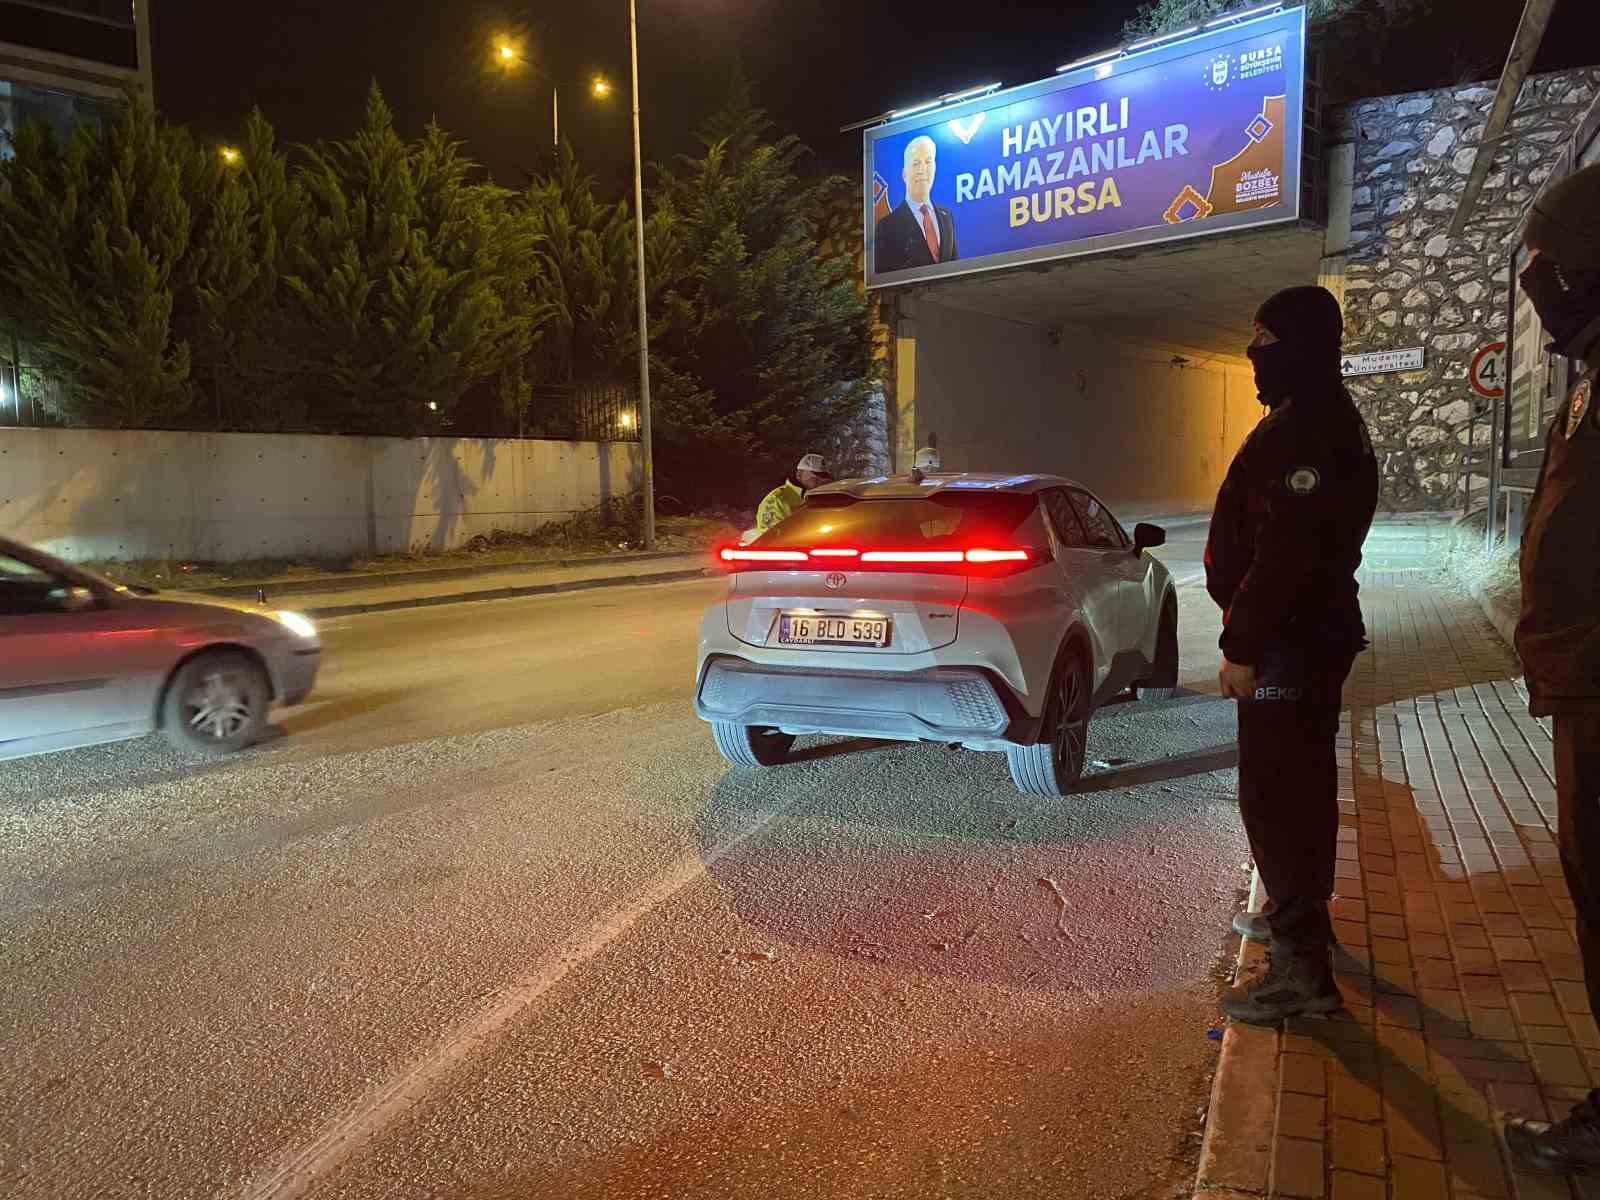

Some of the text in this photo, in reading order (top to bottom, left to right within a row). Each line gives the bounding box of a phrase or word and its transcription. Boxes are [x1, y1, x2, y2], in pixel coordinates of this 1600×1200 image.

[1240, 45, 1282, 64] BURSA
[1002, 97, 1129, 157] HAYIRLI
[956, 123, 1189, 203] RAMAZANLAR
[1236, 175, 1279, 192] BOZBEY
[1009, 177, 1121, 228] BURSA
[1362, 352, 1411, 363] Mudanya
[793, 619, 809, 637] 16
[817, 620, 846, 639] BLD
[853, 621, 883, 640] 539
